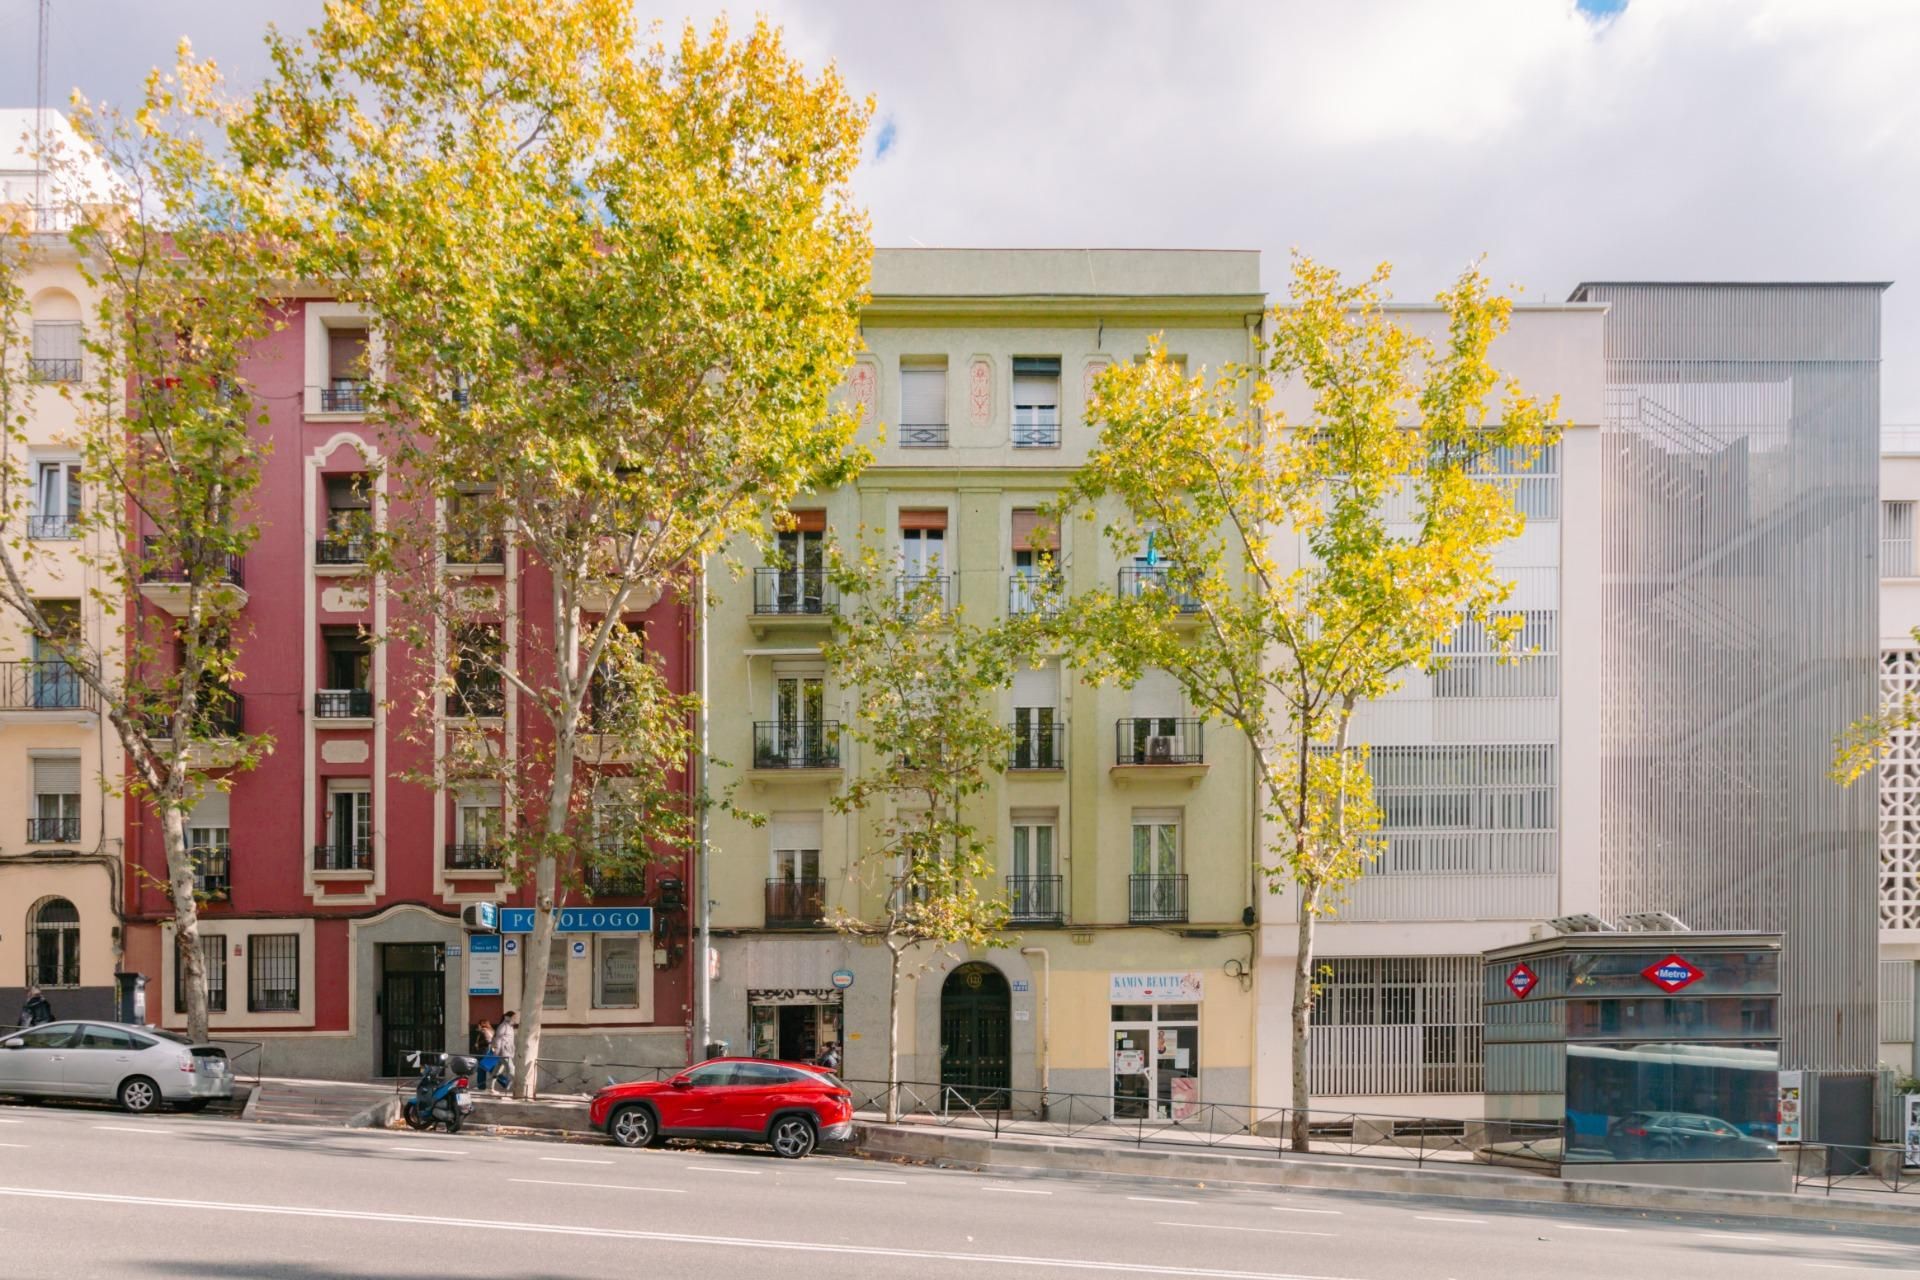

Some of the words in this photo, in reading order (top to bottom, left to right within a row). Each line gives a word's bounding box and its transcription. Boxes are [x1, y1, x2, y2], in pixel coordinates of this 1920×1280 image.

[513, 912, 640, 927] POOLOGO
[1660, 969, 1687, 979] Metro
[1114, 976, 1143, 988] KAMIN
[1146, 976, 1180, 988] BEAUTY
